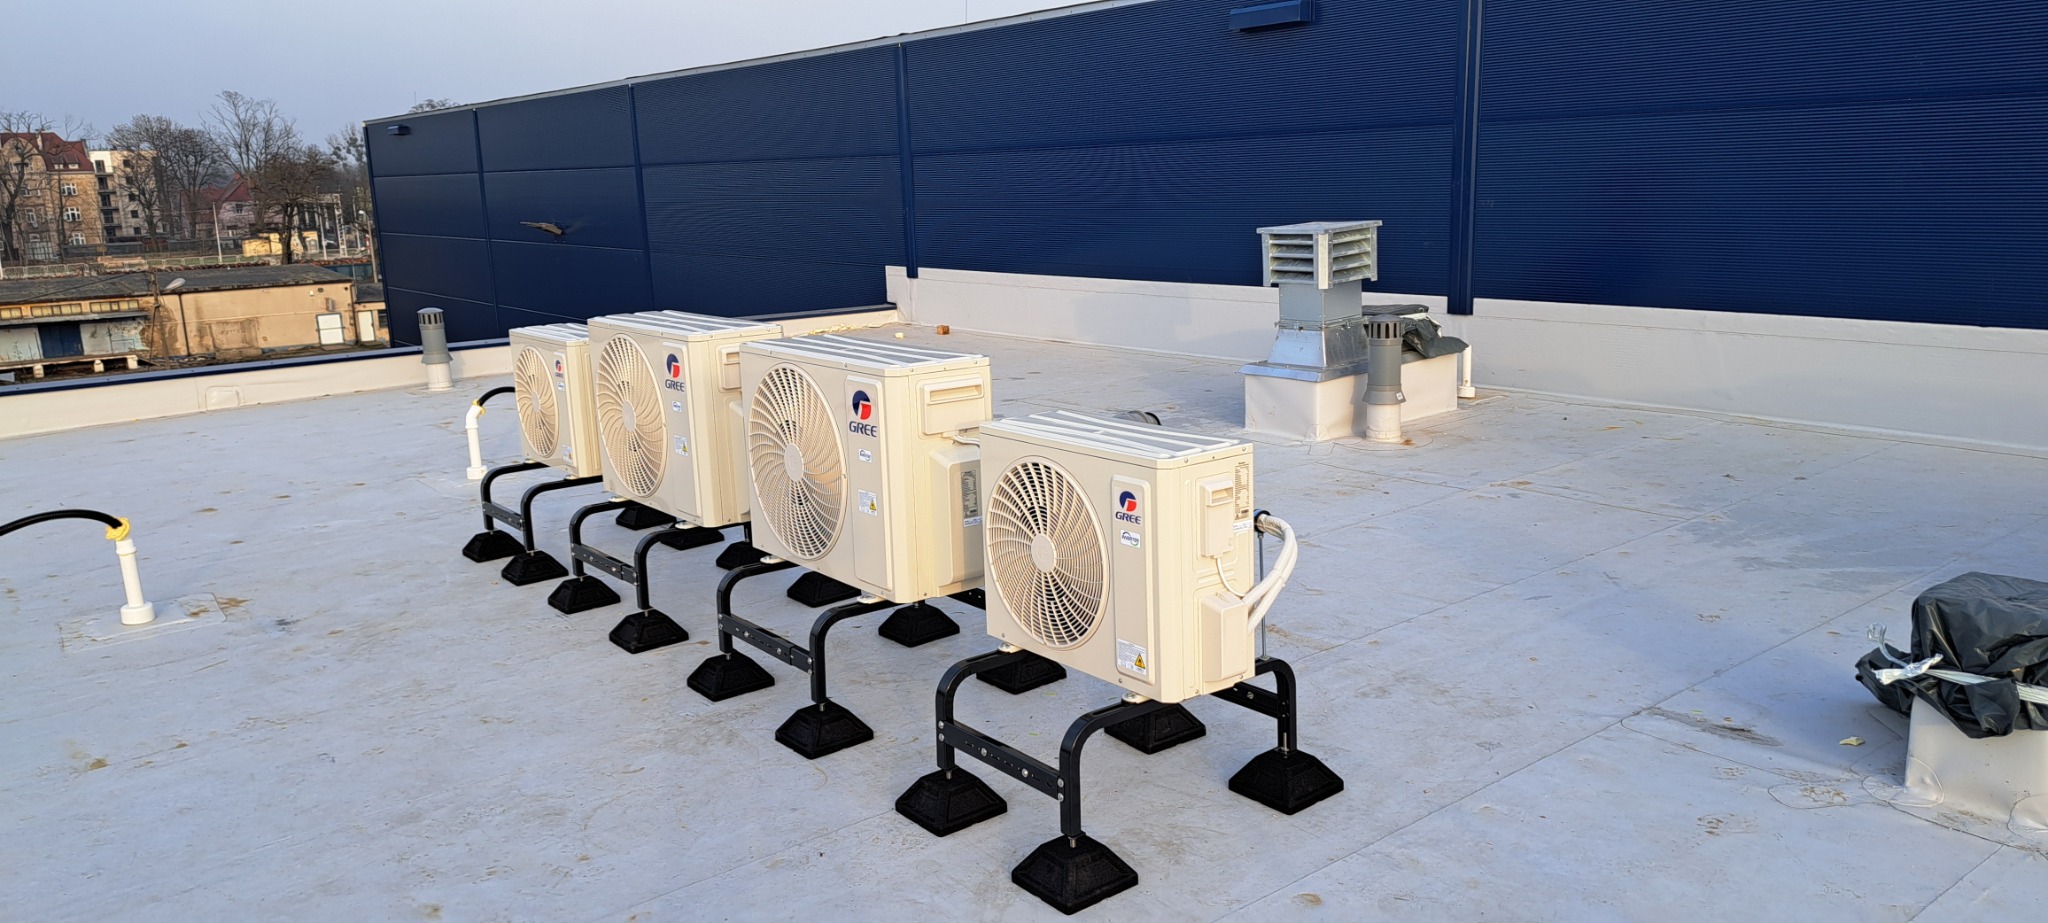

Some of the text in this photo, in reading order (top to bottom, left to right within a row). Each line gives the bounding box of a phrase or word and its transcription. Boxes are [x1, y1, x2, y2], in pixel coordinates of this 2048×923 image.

[664, 378, 686, 393] GREE
[848, 420, 878, 438] GREE
[1115, 510, 1142, 526] GREE
